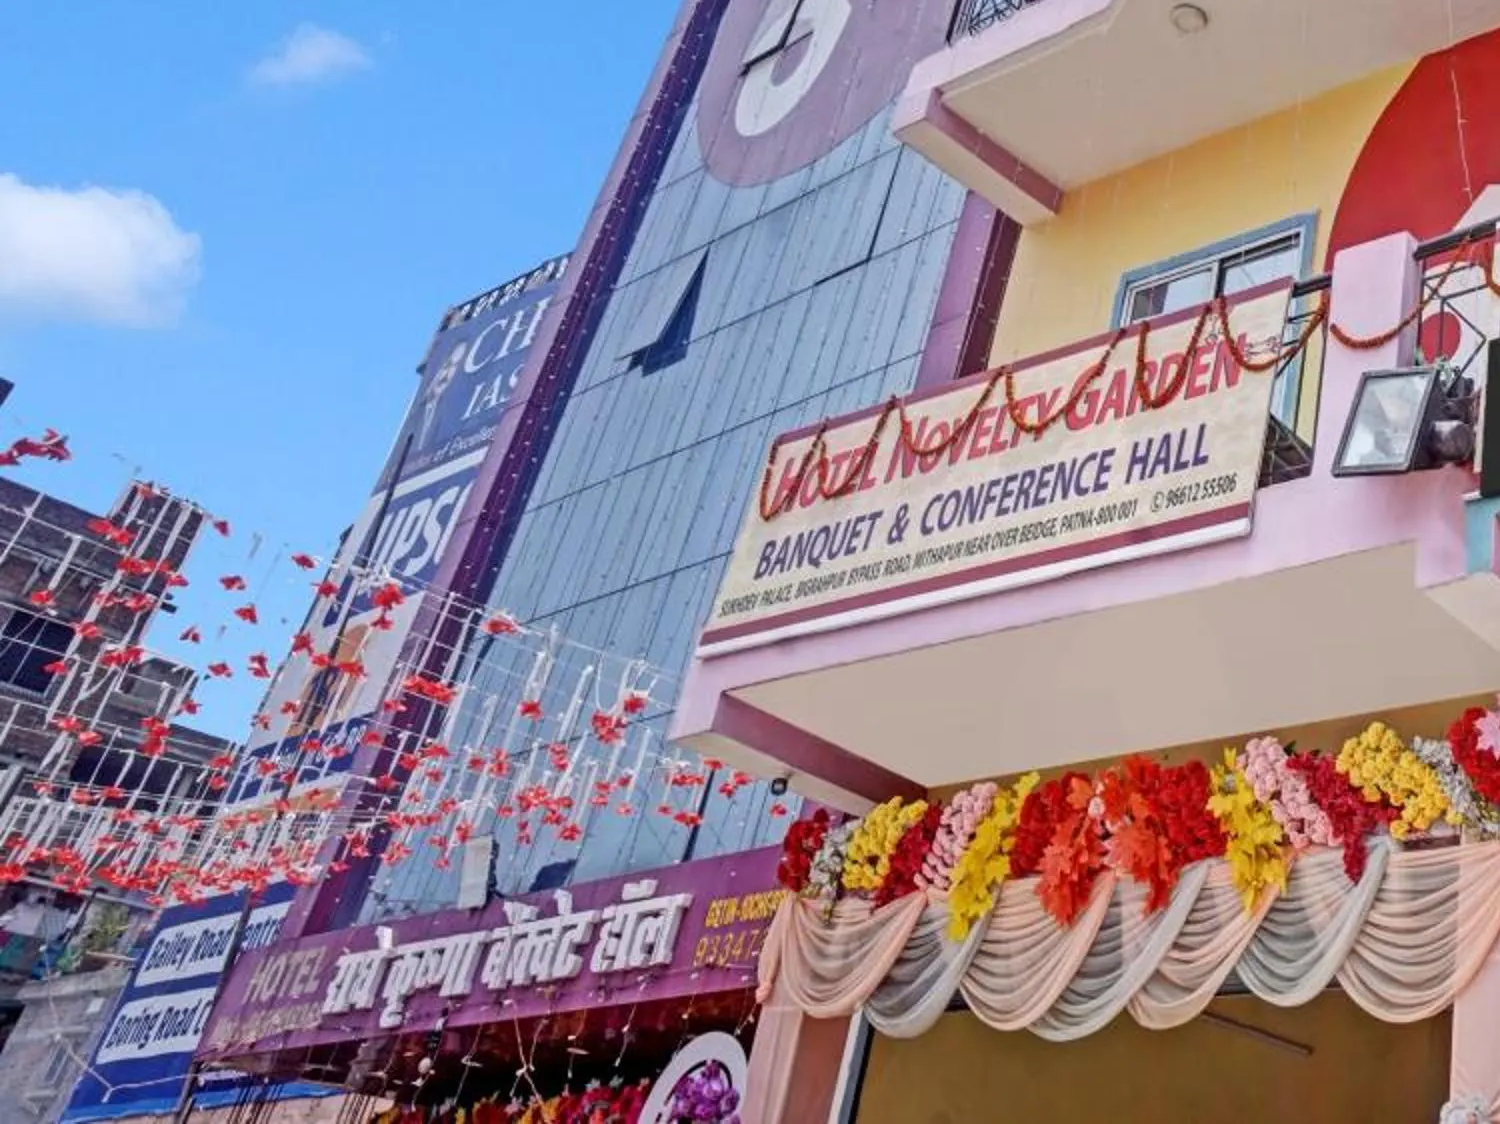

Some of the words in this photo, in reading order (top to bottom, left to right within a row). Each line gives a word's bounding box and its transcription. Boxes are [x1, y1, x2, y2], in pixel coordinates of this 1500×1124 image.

[883, 387, 1061, 484] NOVELTY
[1064, 332, 1246, 431] GARDEN
[753, 510, 884, 580] BANQUET
[887, 502, 910, 545] &
[920, 447, 1117, 536] CONFERENCE
[1125, 423, 1209, 484] HALL
[1114, 499, 1138, 522] 001
[1165, 482, 1203, 510] 96612
[1200, 472, 1238, 501] 55506
[145, 929, 198, 972] Bailey
[190, 924, 235, 962] Road
[590, 879, 693, 973] हॉल
[241, 946, 327, 1005] HOTEL
[153, 1004, 196, 1042] Road
